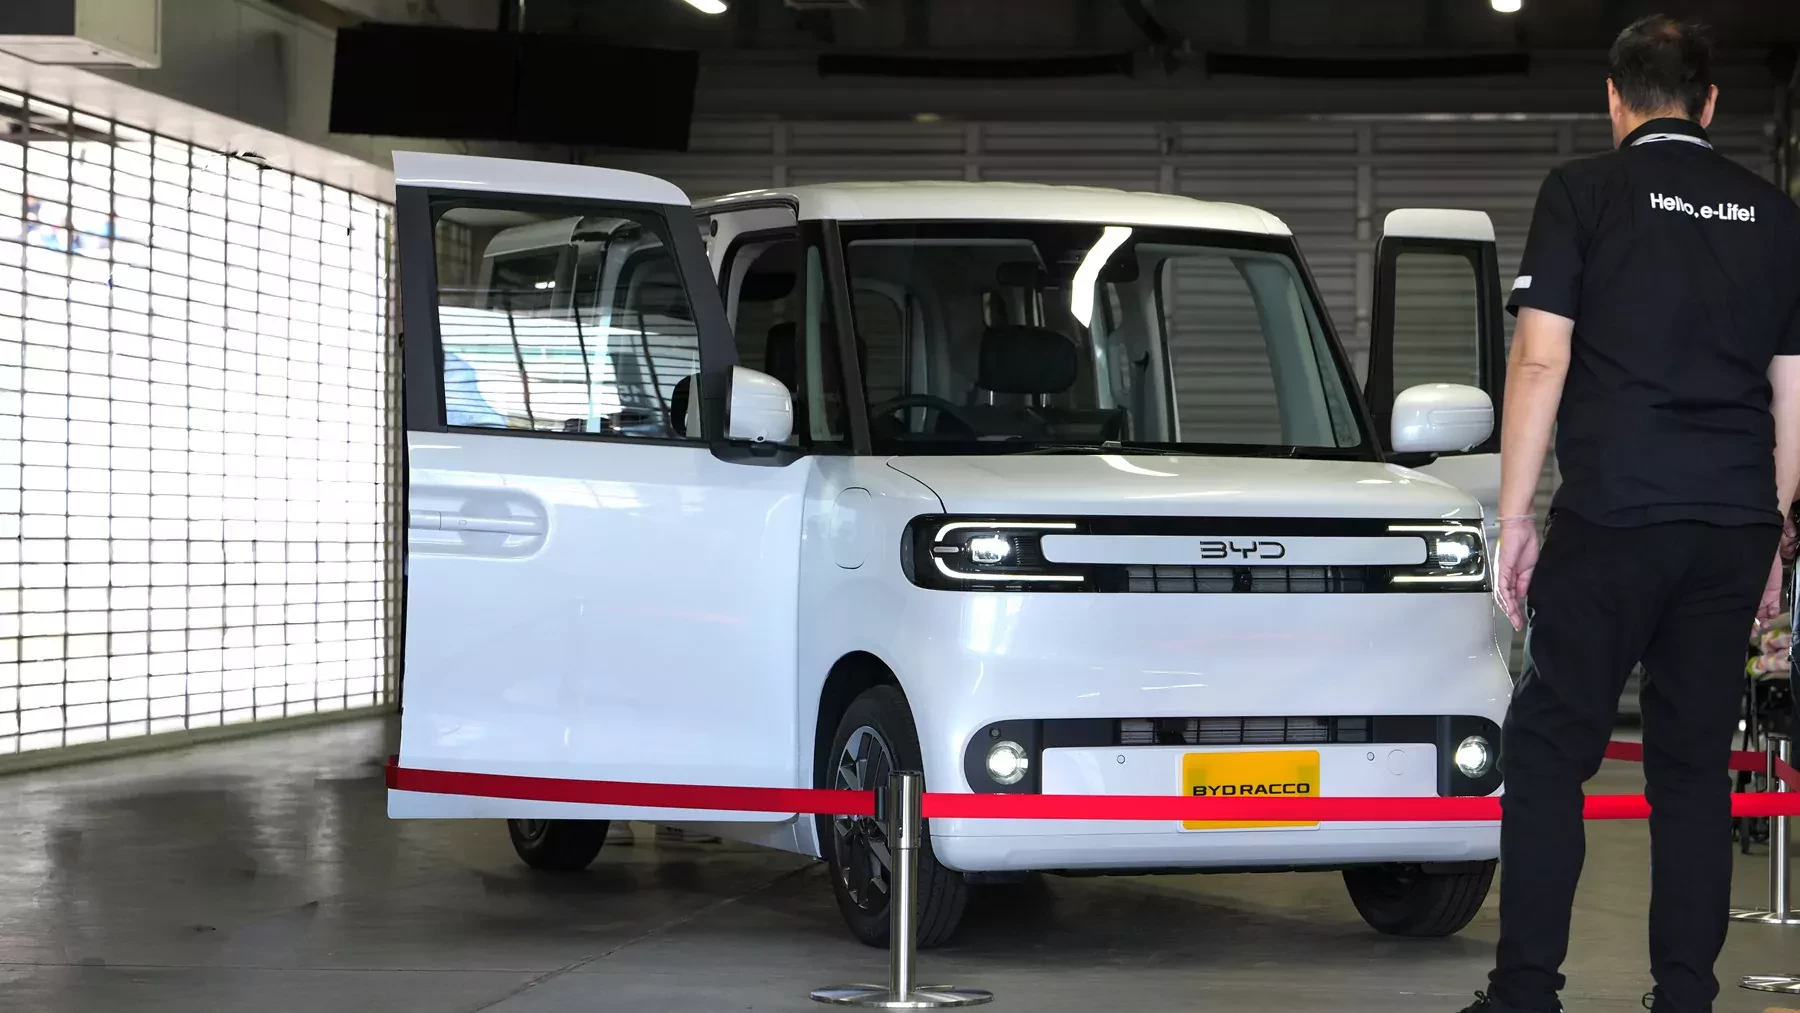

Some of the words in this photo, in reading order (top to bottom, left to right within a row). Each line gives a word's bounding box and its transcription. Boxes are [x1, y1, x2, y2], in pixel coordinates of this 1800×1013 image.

[1199, 540, 1286, 559] BYD
[1192, 785, 1236, 797] BYD
[1239, 783, 1310, 795] RACCO
